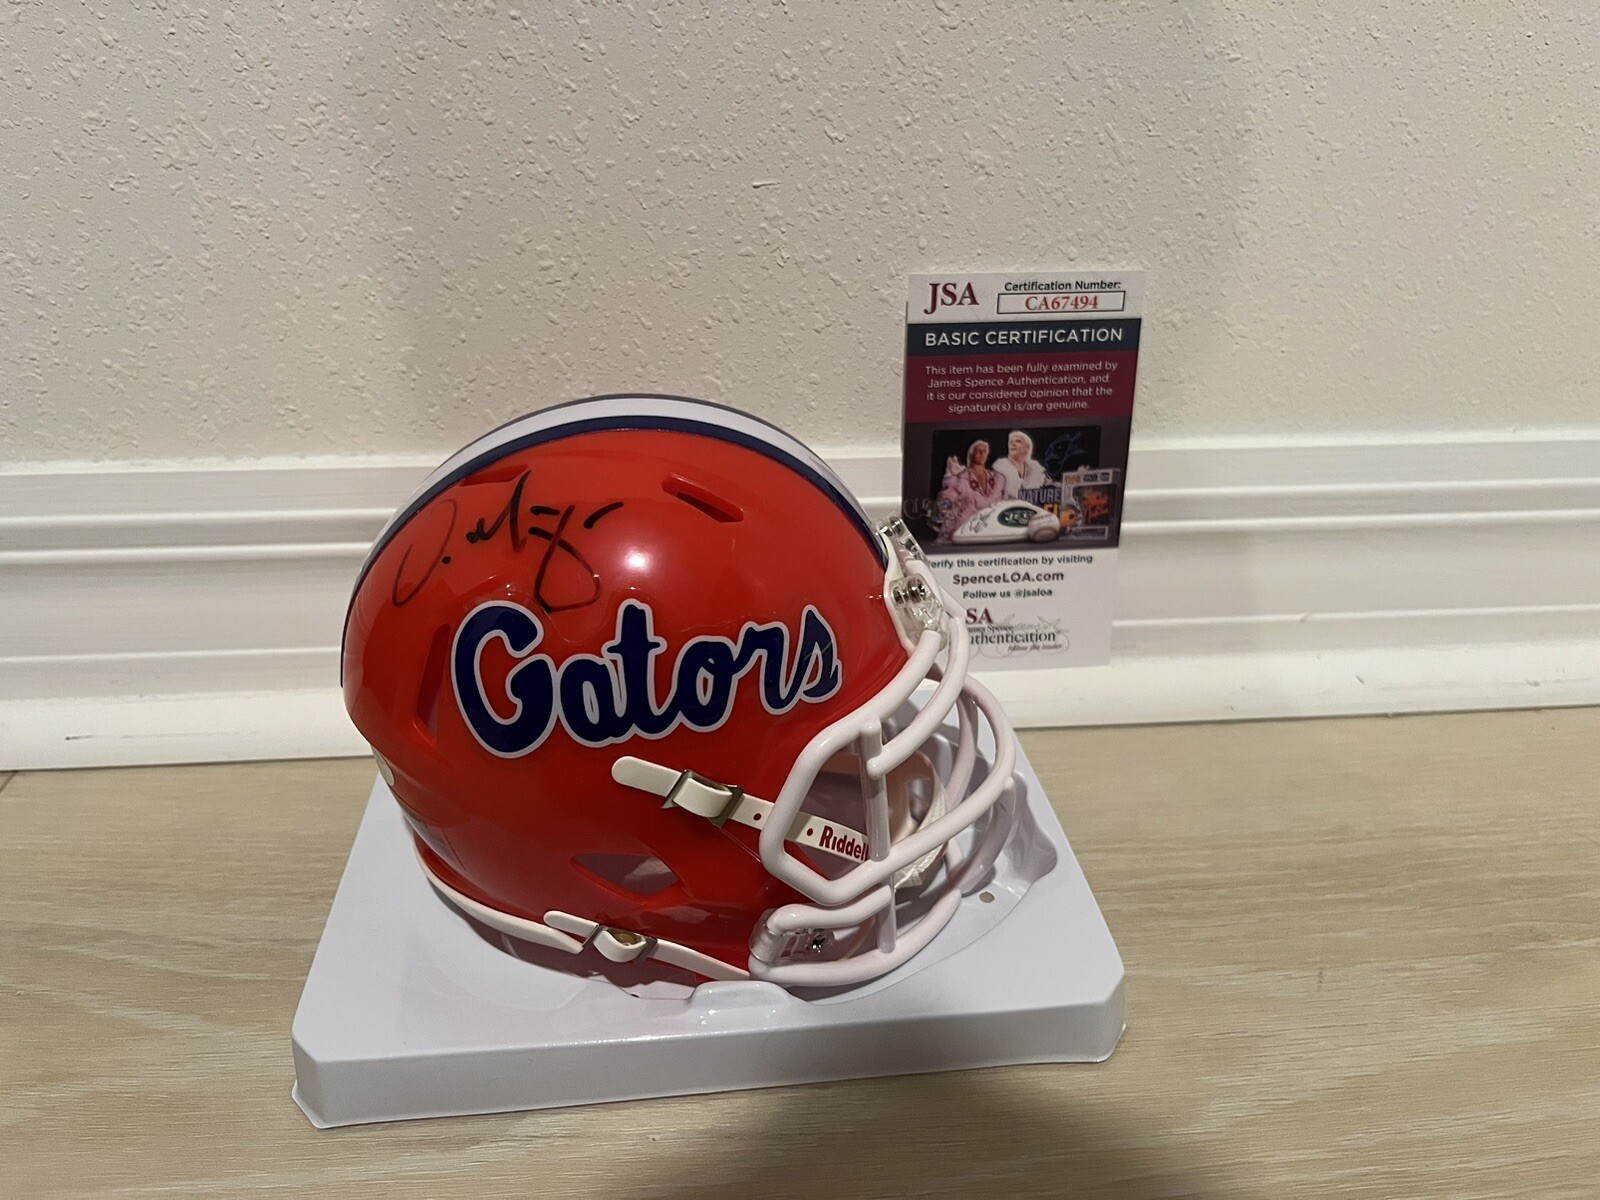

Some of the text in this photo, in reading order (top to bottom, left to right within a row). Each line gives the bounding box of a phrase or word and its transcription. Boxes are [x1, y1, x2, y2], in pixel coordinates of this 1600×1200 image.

[1004, 280, 1121, 291] Certification Number:
[924, 282, 979, 314] JSA
[1025, 295, 1099, 311] CA67494
[925, 328, 1122, 346] BASIC CERTIFICATION
[925, 361, 1118, 375] This item has been fully examined by
[928, 374, 1109, 389] James Spence Authentication, and
[927, 387, 1113, 401] it is our considered opinion that the
[948, 401, 1089, 414] signature(s) is/are genuine.
[929, 555, 1093, 569] erify this certification by visiting
[953, 572, 1064, 585] SpenceLOA.com
[963, 591, 996, 599] Follow
[1015, 588, 1052, 597] @jsaloa
[966, 608, 993, 624] SA
[451, 599, 842, 758] Gators
[819, 825, 869, 861] Riddell
